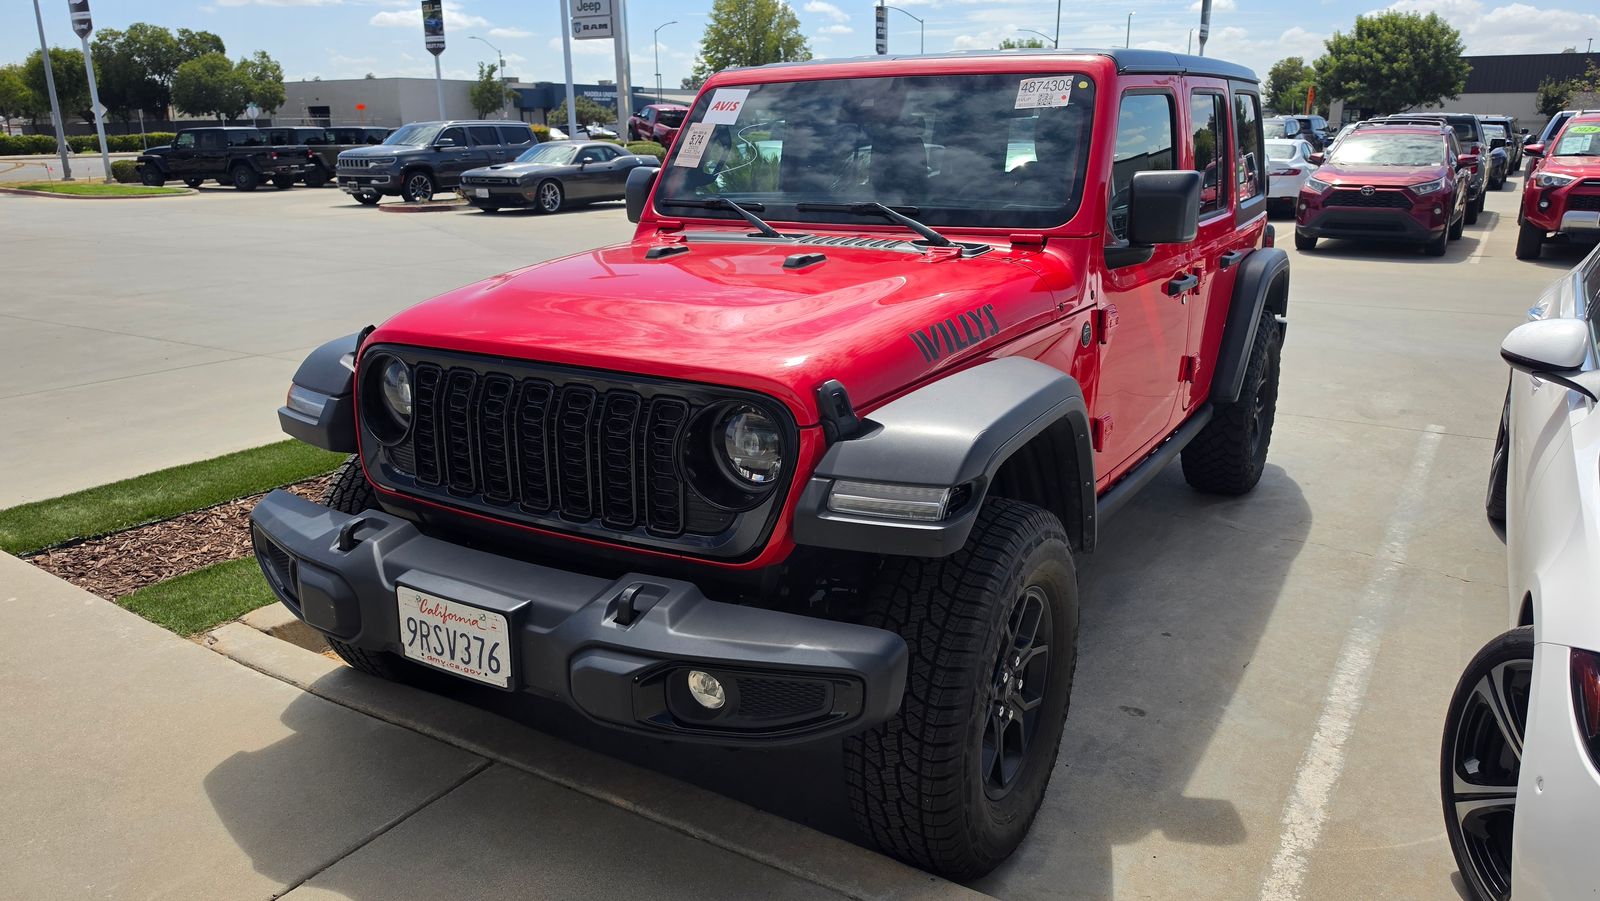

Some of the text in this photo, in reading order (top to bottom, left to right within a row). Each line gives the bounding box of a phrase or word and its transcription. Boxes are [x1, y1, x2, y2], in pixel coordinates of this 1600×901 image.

[577, 0, 601, 13] Jeep
[1021, 79, 1072, 93] 4874309
[712, 101, 740, 111] AVIS
[909, 304, 1000, 363] WILLYS
[420, 599, 486, 630] California
[406, 617, 501, 674] 9RSV376
